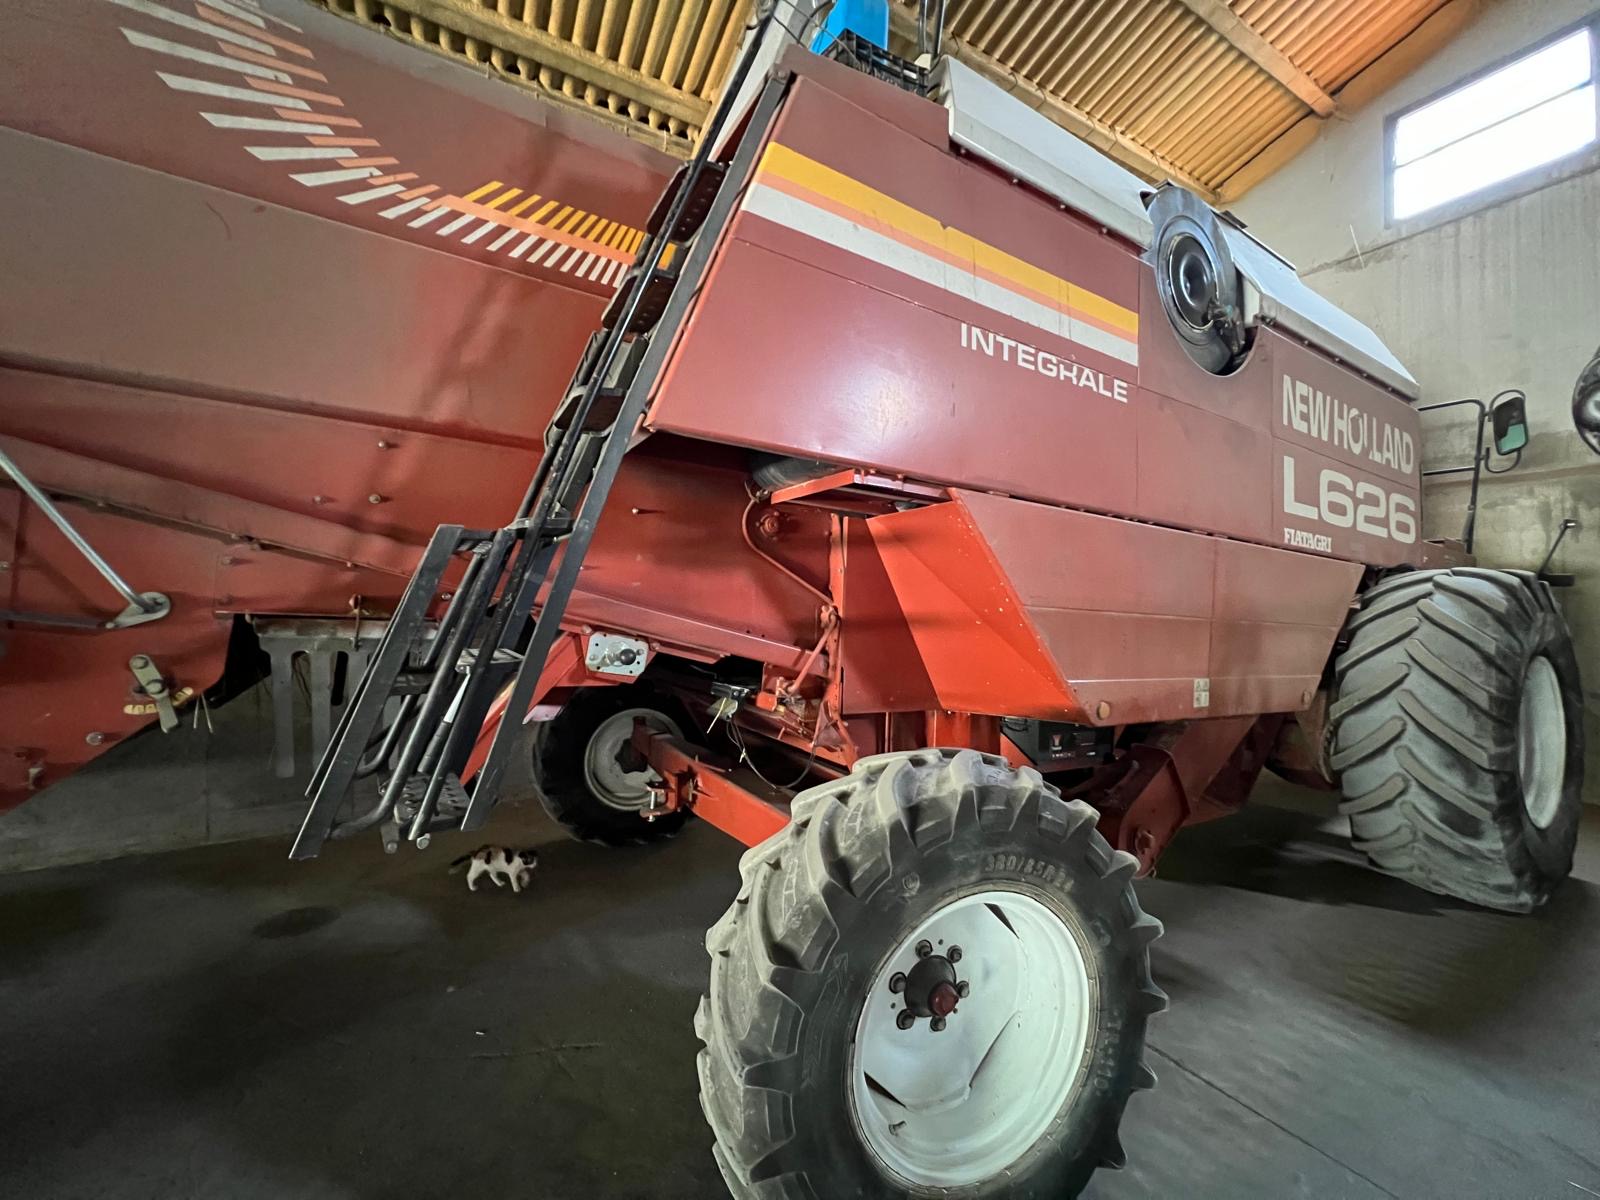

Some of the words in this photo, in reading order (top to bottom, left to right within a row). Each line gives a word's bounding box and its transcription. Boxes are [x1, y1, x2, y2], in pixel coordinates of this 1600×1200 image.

[961, 323, 1128, 403] INTEGRALE
[1283, 375, 1330, 442] NEW
[1284, 456, 1416, 543] L626
[1284, 528, 1332, 553] FIATAGRI
